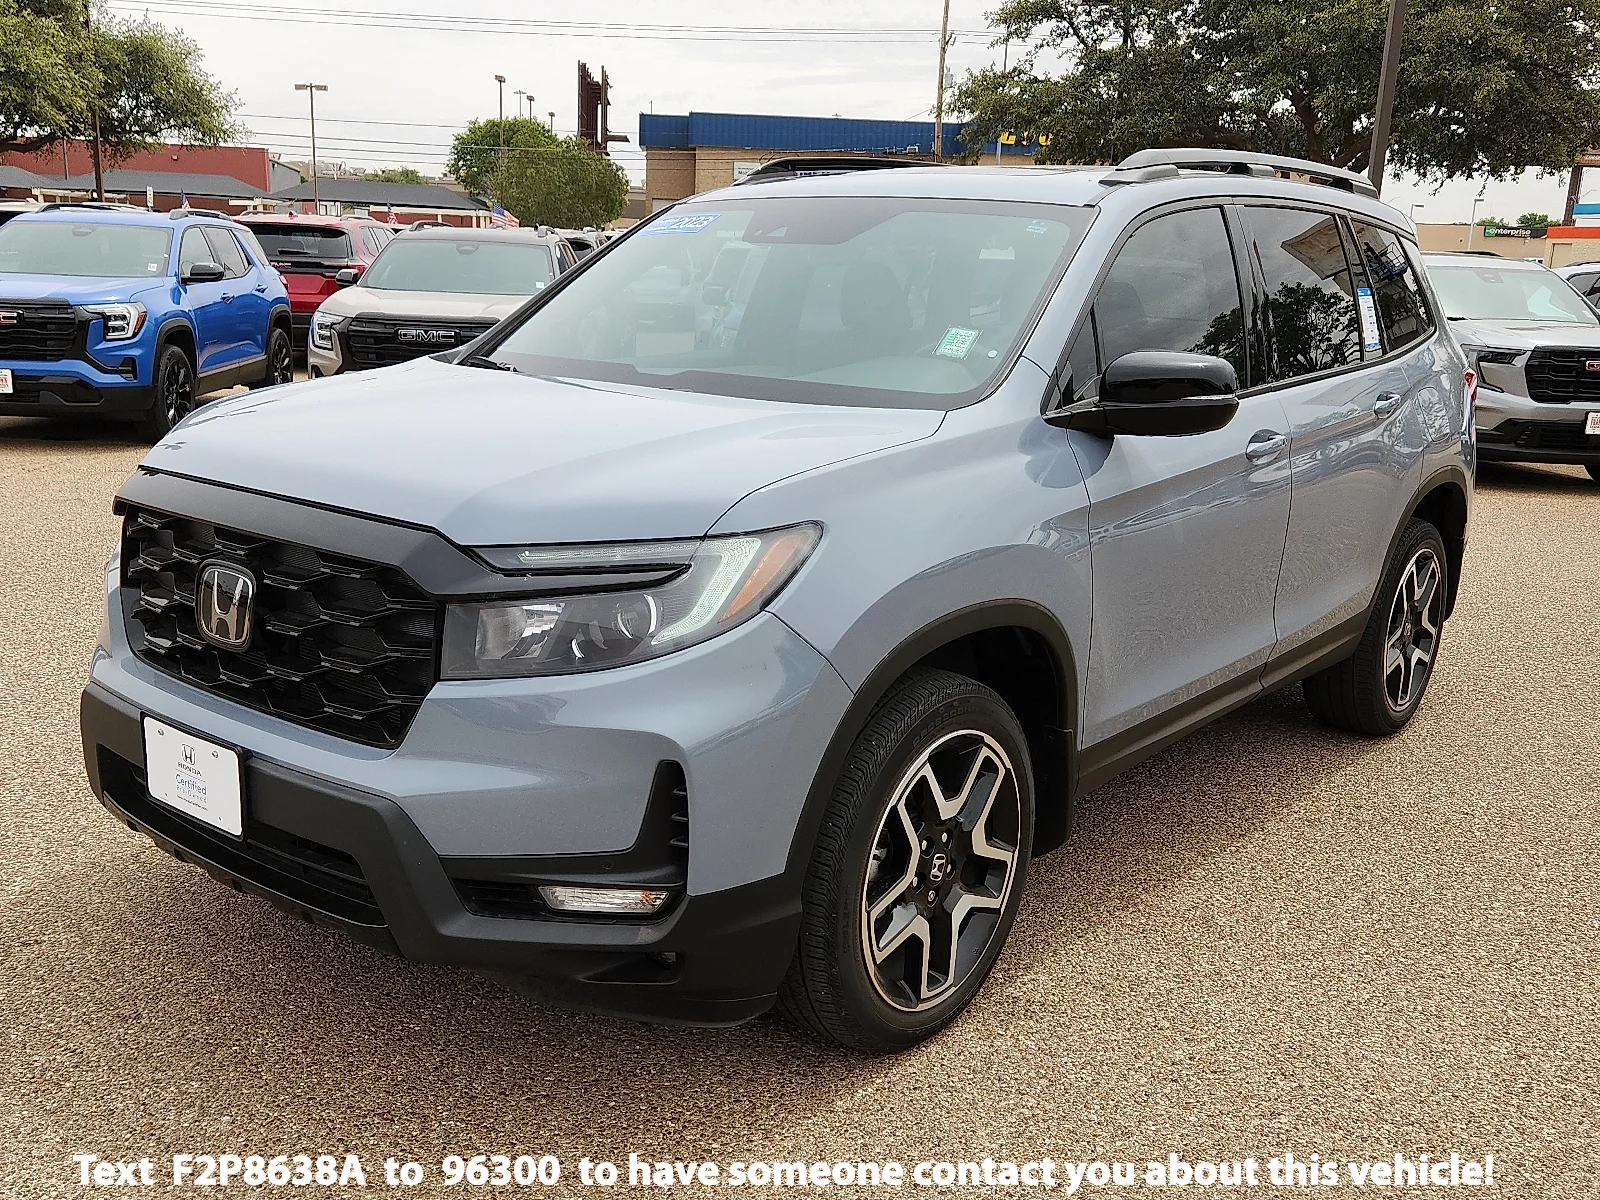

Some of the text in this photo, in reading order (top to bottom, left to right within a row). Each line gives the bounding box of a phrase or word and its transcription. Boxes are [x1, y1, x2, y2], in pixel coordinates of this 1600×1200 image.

[669, 216, 714, 229] 2023
[1486, 228, 1531, 236] enterprise
[398, 329, 455, 343] GMC
[177, 761, 202, 777] HONDA
[175, 773, 207, 796] Certified
